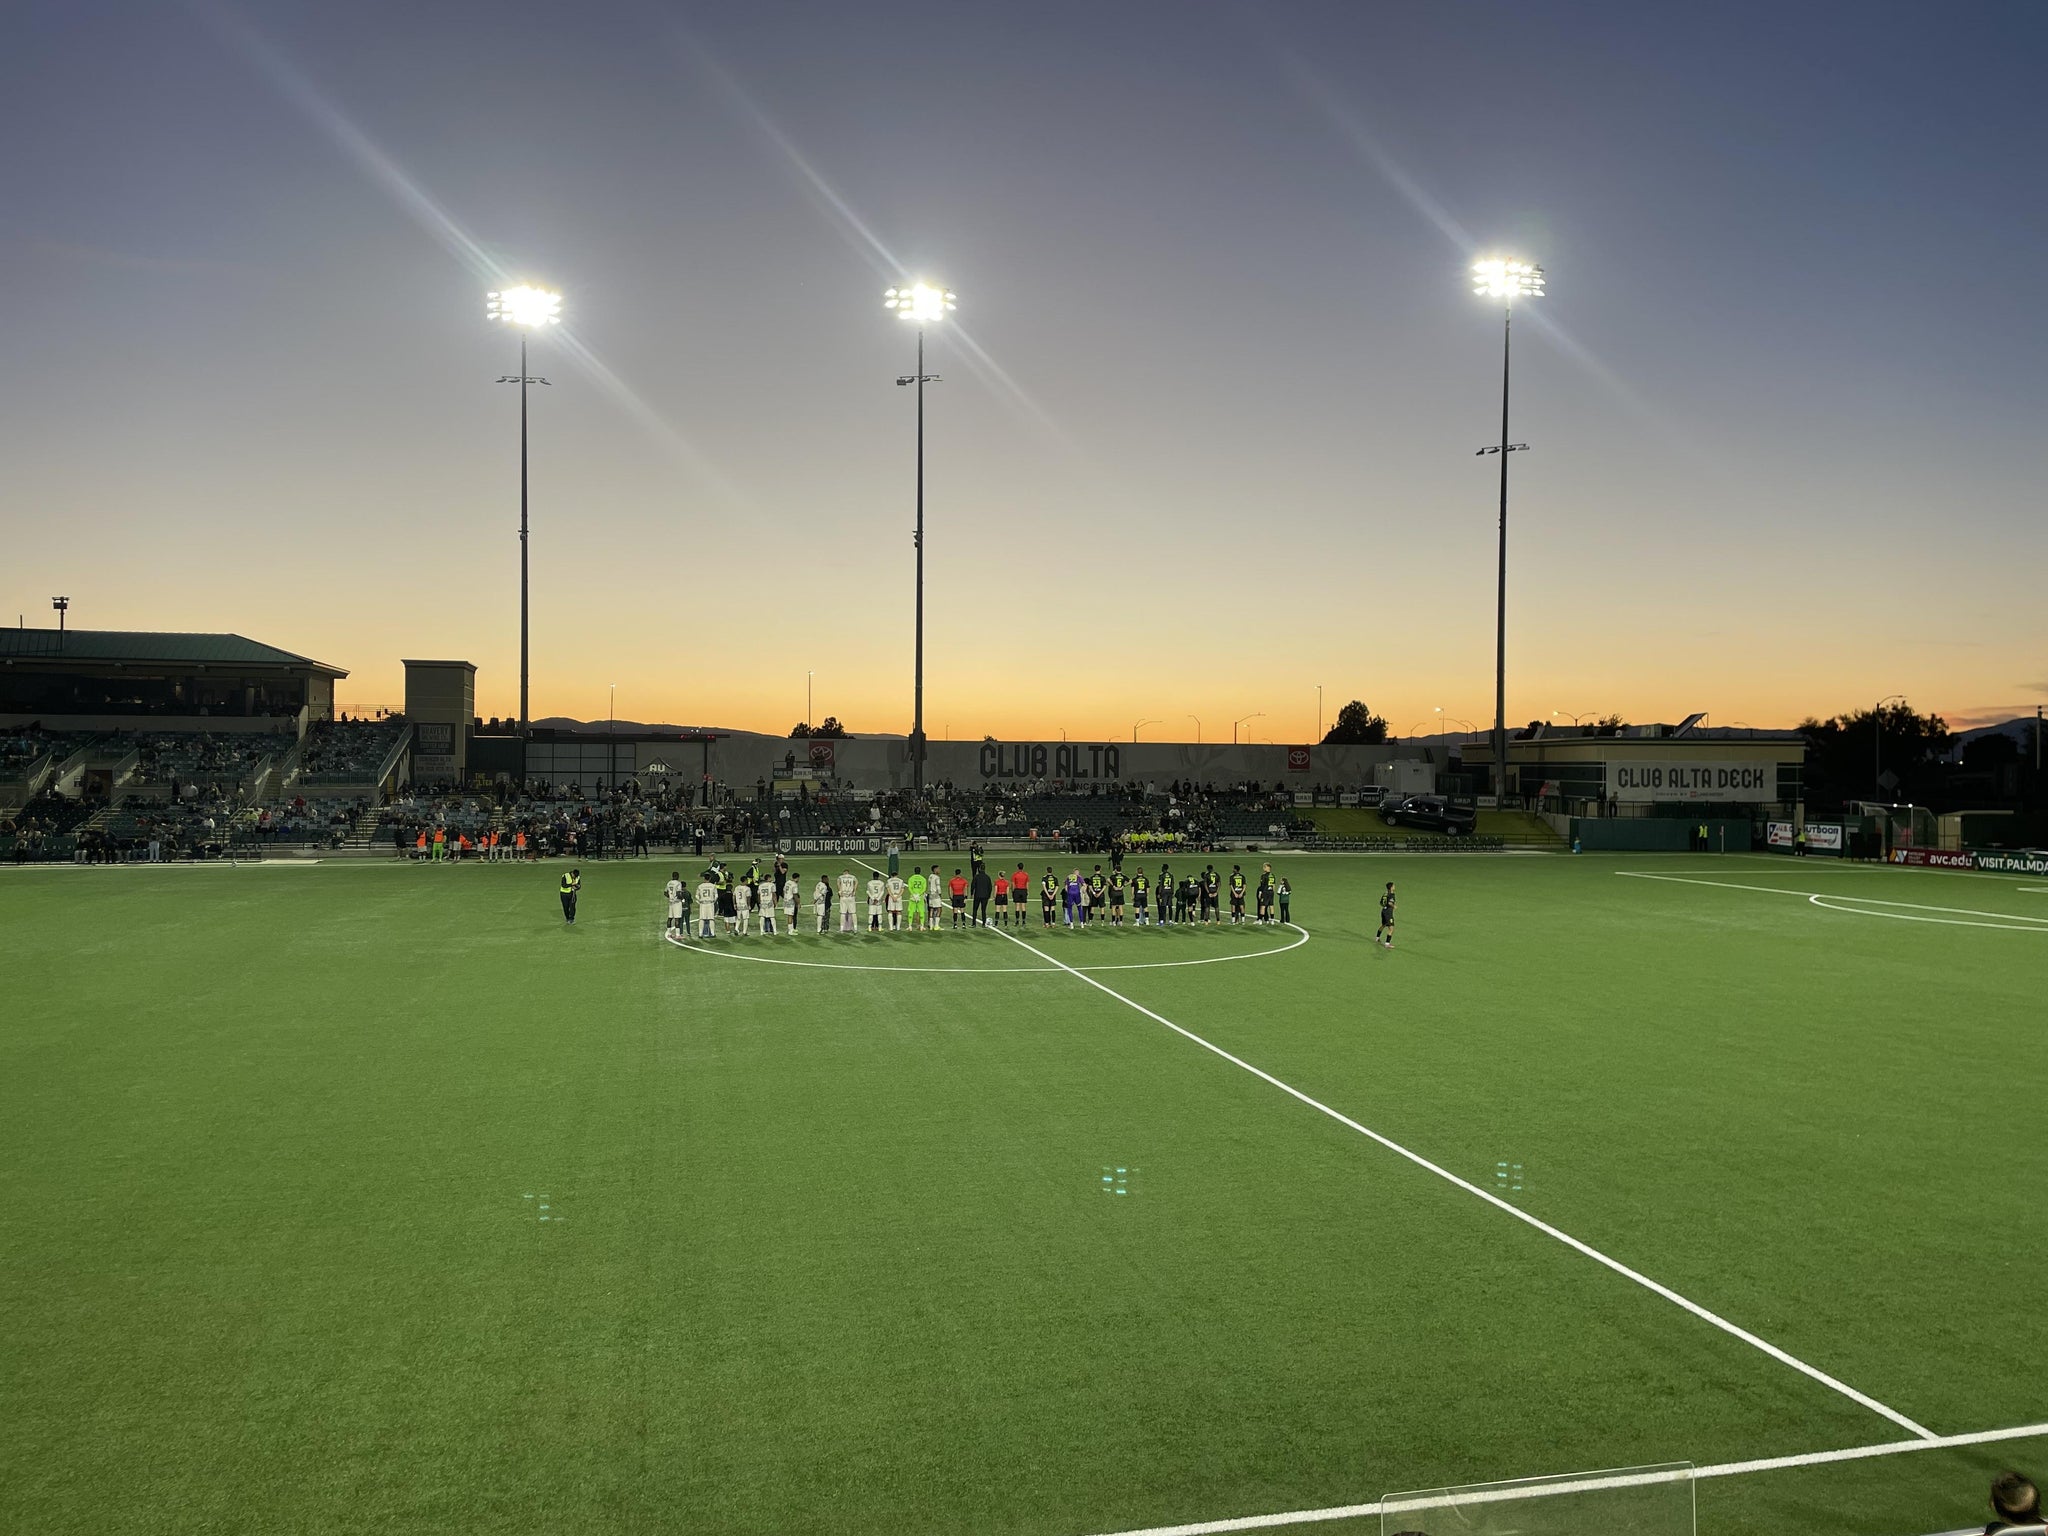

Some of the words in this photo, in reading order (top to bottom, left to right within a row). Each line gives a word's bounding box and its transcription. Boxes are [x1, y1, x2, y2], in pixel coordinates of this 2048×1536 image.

[980, 744, 1047, 778] CLUB
[1056, 744, 1119, 778] ALTA
[1618, 768, 1662, 788] CLUB
[1669, 768, 1712, 788] ALTA
[1718, 769, 1764, 788] DECK
[1930, 854, 1973, 867] avc.edu
[1978, 857, 2005, 869] VISIT
